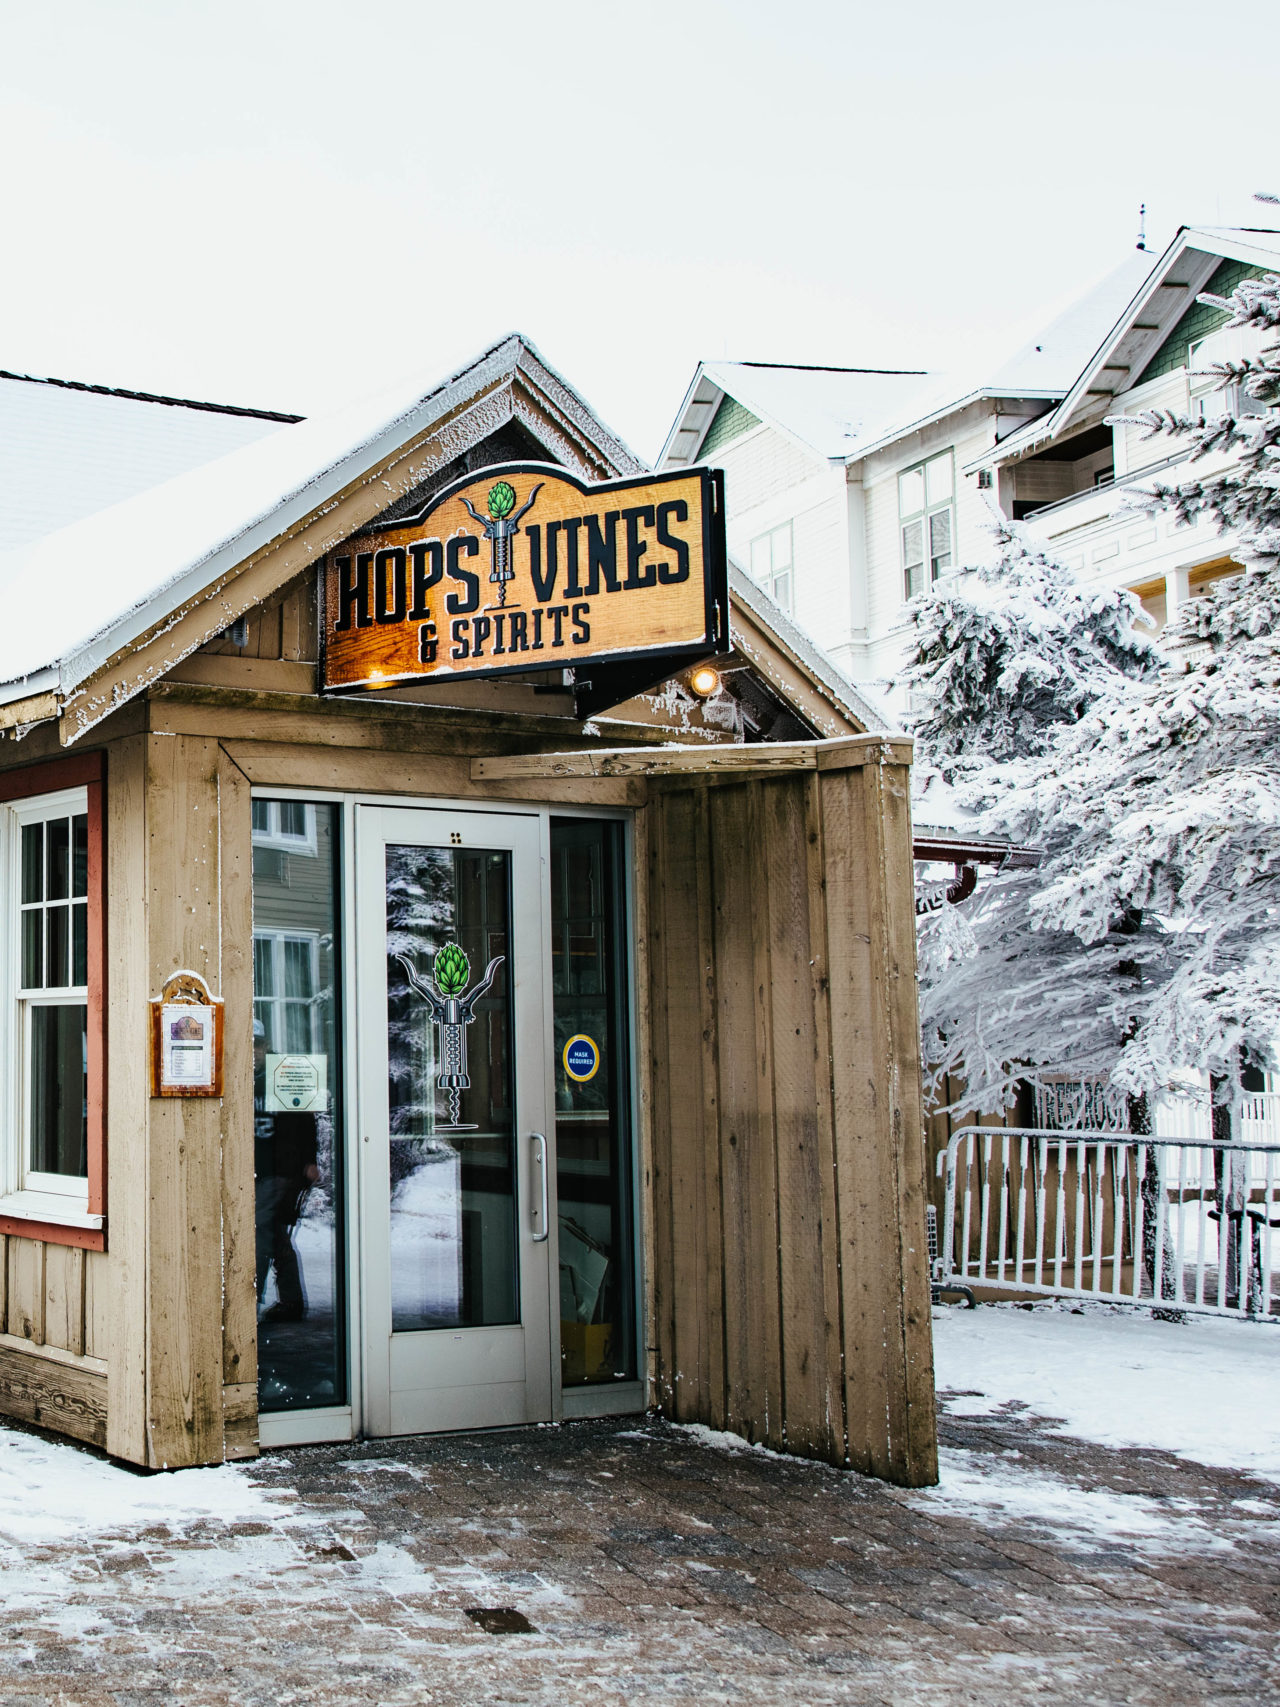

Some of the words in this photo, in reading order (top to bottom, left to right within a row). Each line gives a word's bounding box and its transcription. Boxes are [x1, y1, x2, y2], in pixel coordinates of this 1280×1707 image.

[334, 535, 480, 632] HOPS
[526, 498, 689, 603] VINES
[419, 622, 439, 664] &
[451, 602, 591, 661] SPIRITS
